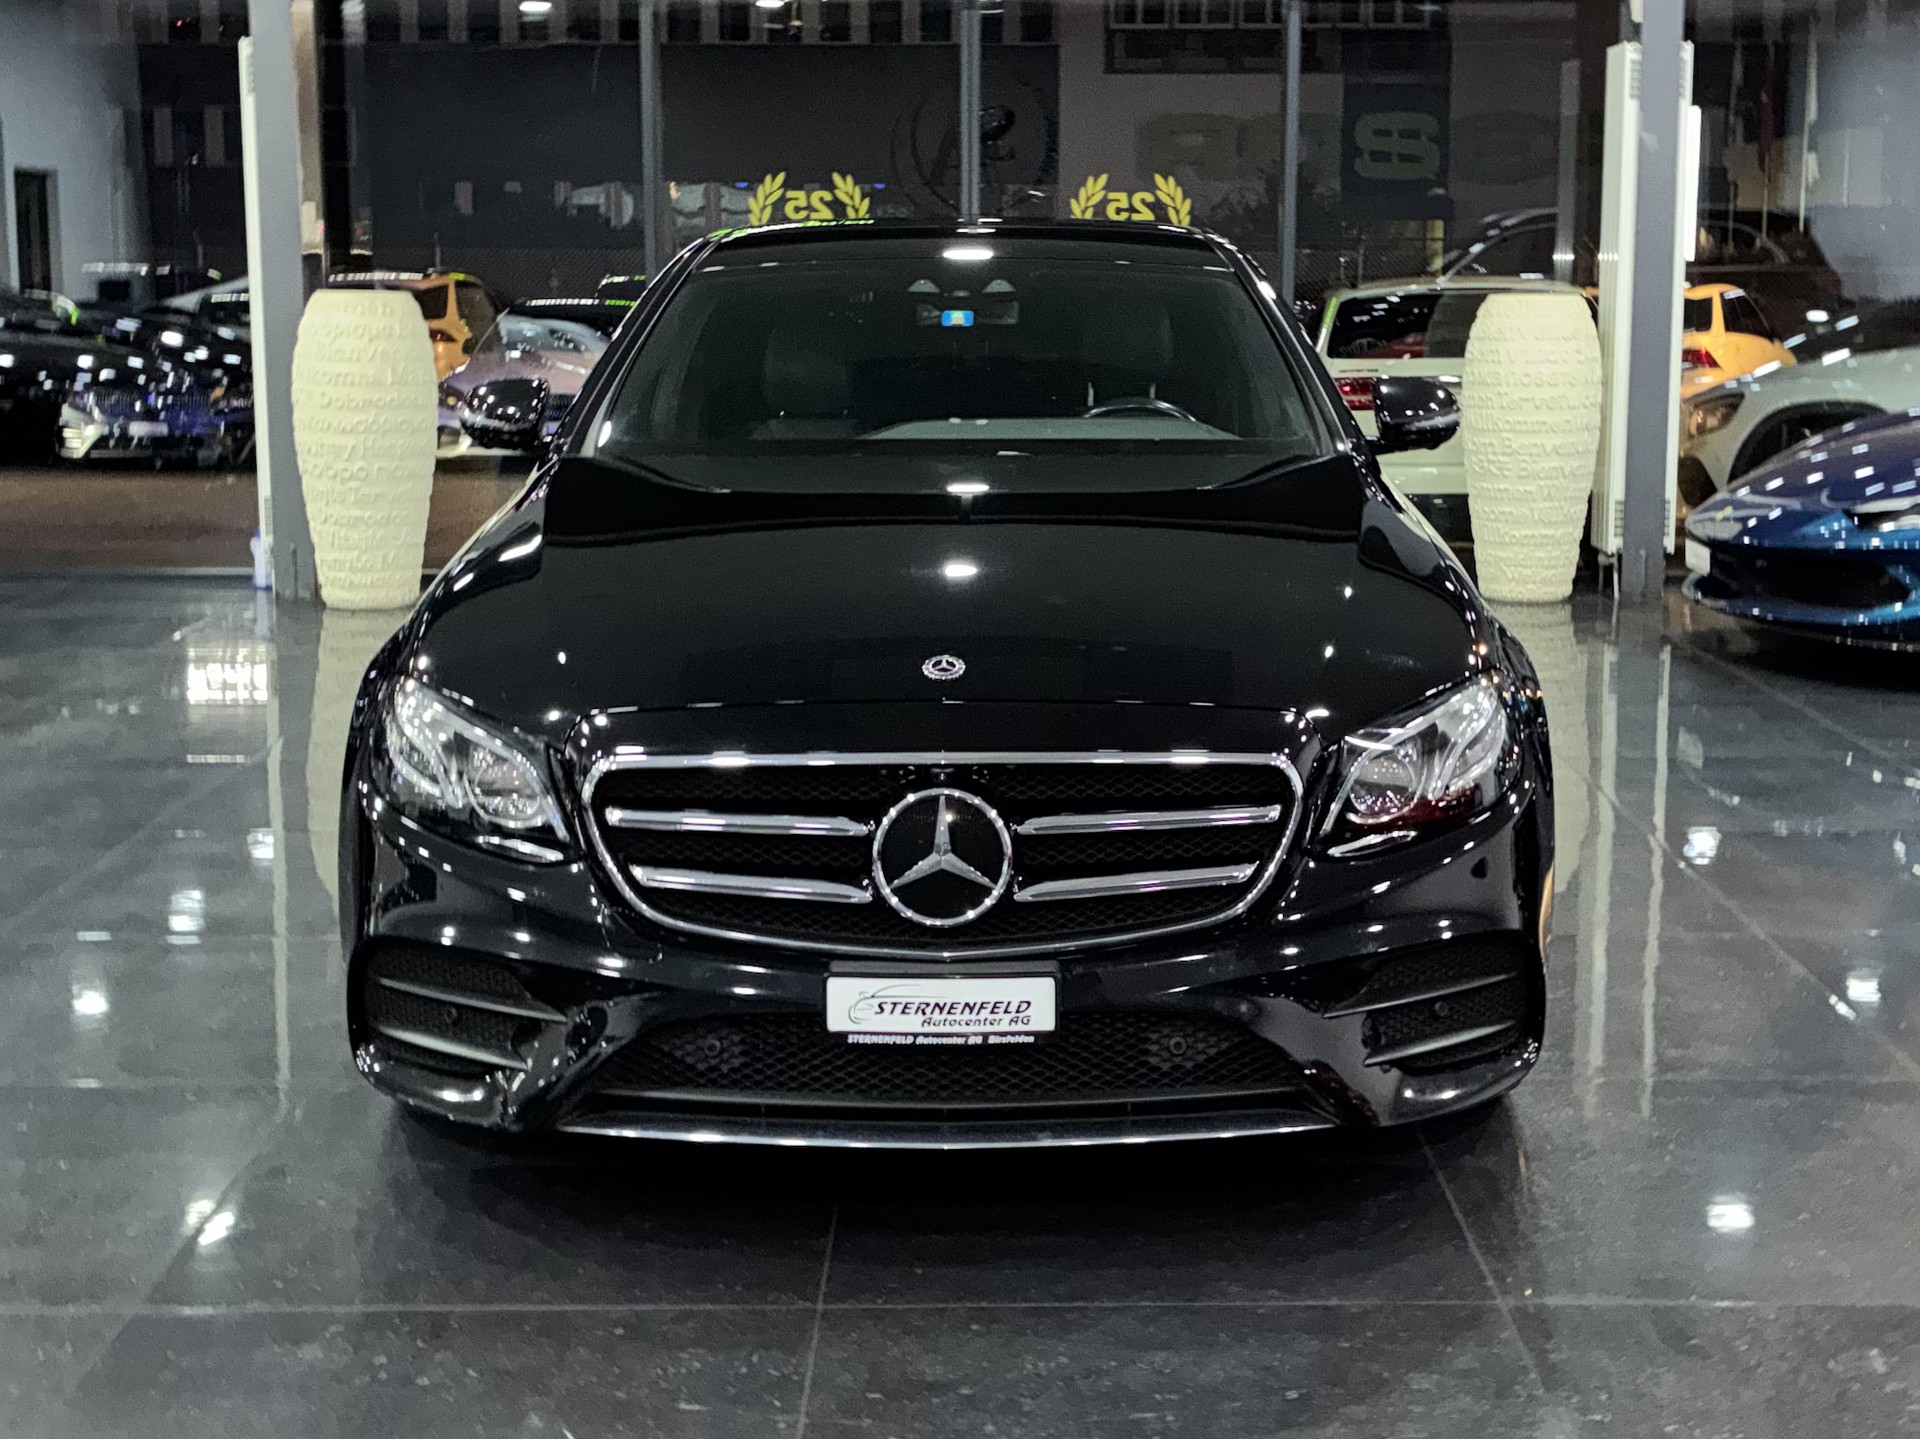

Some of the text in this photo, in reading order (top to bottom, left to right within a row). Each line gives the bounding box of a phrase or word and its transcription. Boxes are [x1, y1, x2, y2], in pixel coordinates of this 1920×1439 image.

[874, 1000, 1032, 1017] STERNENFELD
[921, 1015, 1032, 1028] Autocenter AG
